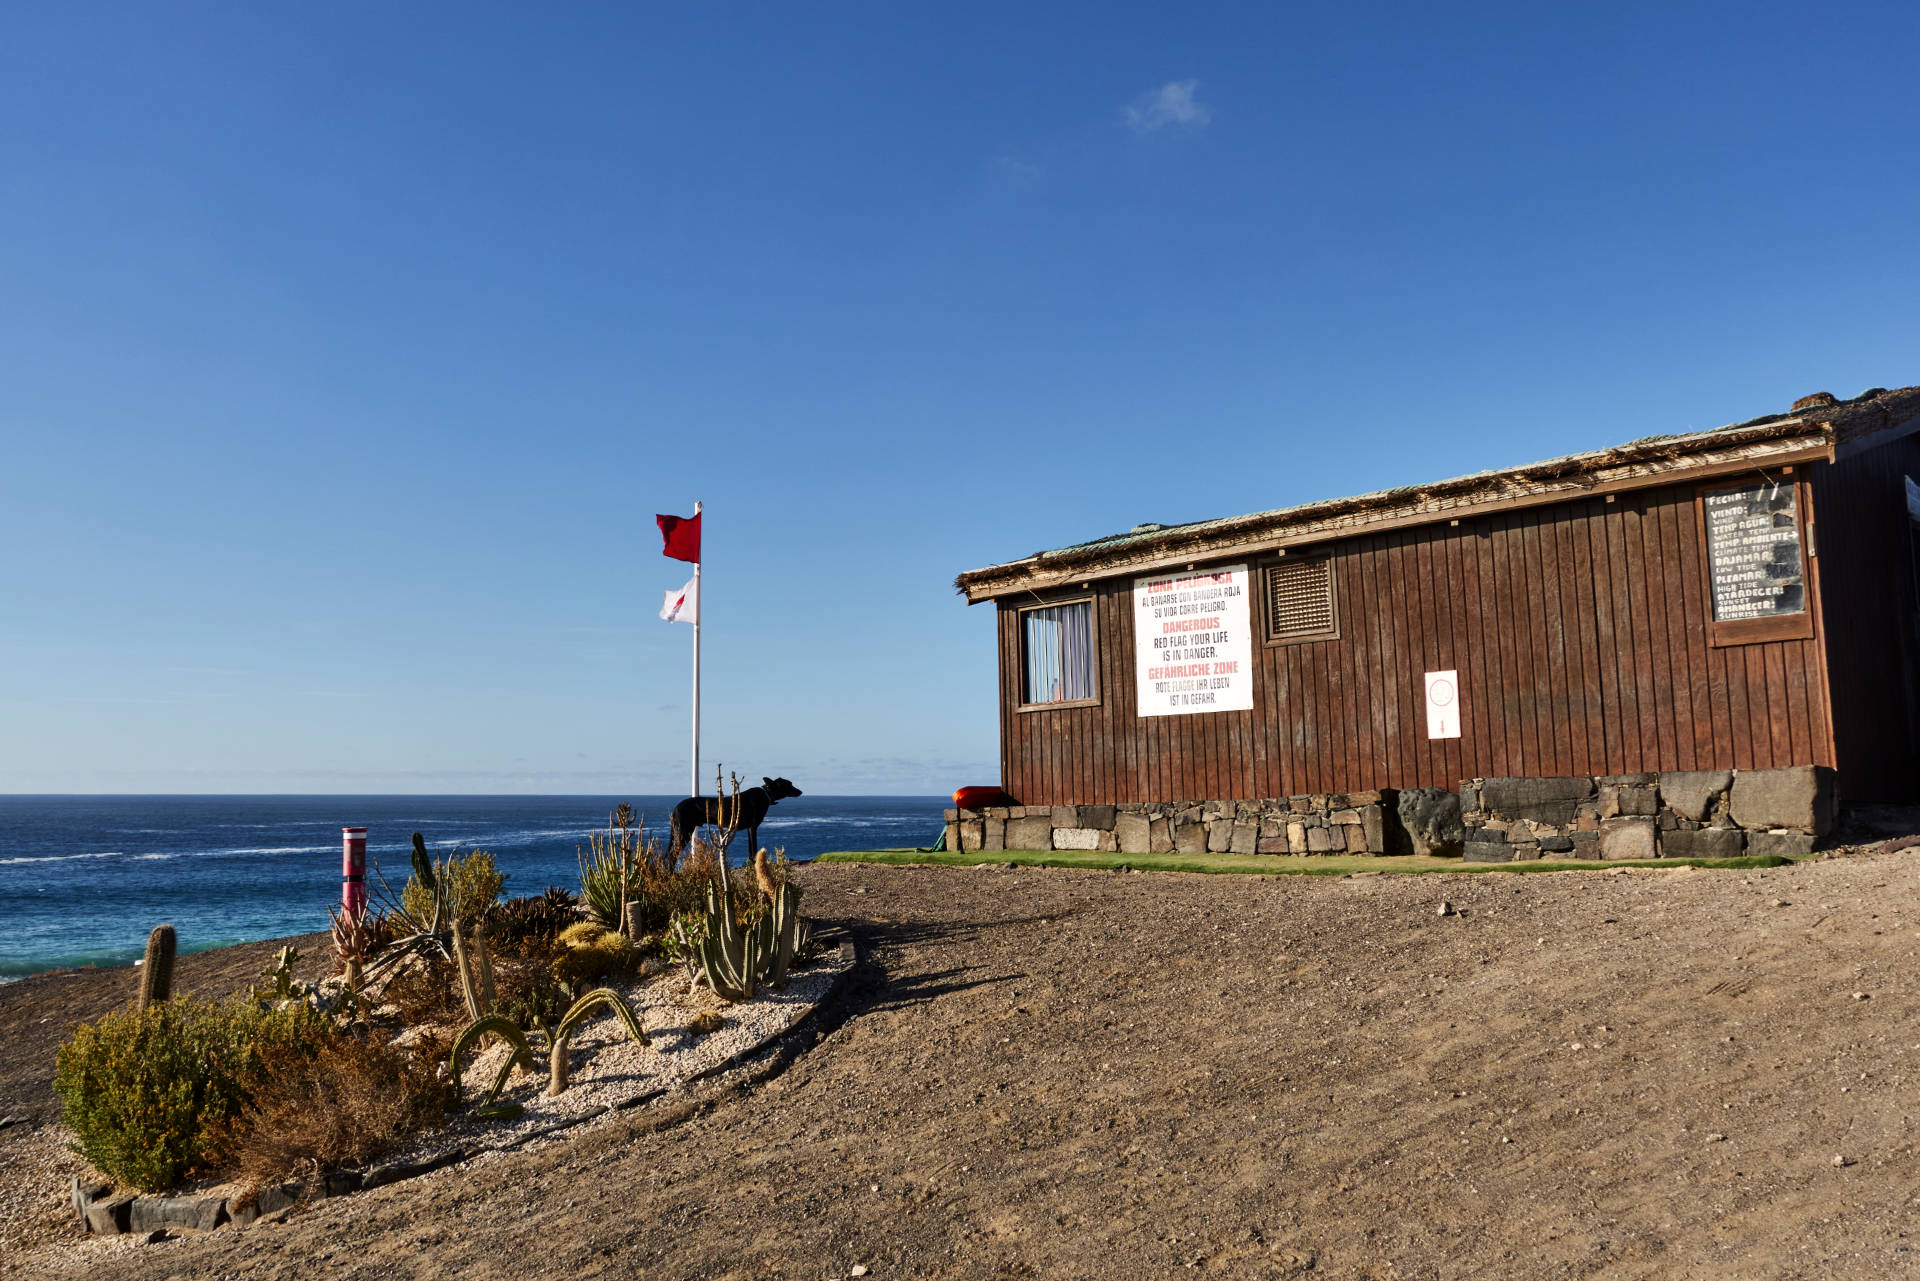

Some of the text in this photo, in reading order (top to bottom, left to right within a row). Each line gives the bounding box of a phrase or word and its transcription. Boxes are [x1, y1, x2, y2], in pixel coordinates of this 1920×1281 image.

[1711, 506, 1747, 518] VIENTO:
[1714, 531, 1743, 541] WATER
[1743, 532, 1788, 545] AMBIENTE
[1715, 547, 1747, 556] CLIMATE
[1148, 580, 1172, 593] ZONA
[1143, 597, 1149, 607] AL
[1179, 592, 1191, 602] CON
[1194, 588, 1222, 601] BANDERA
[1224, 586, 1240, 596] ROJA
[1717, 587, 1784, 600] ATARDECER:
[1718, 601, 1775, 613] AMANECER:
[1719, 598, 1750, 606] SUNSET
[1155, 601, 1227, 618] SU VIDA CORRE PELIGRO.
[1719, 611, 1759, 619] SUNRISE
[1163, 617, 1220, 633] DANGEROUS
[1154, 631, 1228, 648] RED FLAG YOUR LIFE
[1163, 647, 1217, 661] IS IN DANGER.
[1149, 661, 1238, 680] GEFÄHRLICHE ZONE
[1156, 677, 1229, 693] ROTE FLAGGE IHR LEBEN
[1170, 692, 1216, 706] IST IN GEFAHR.
